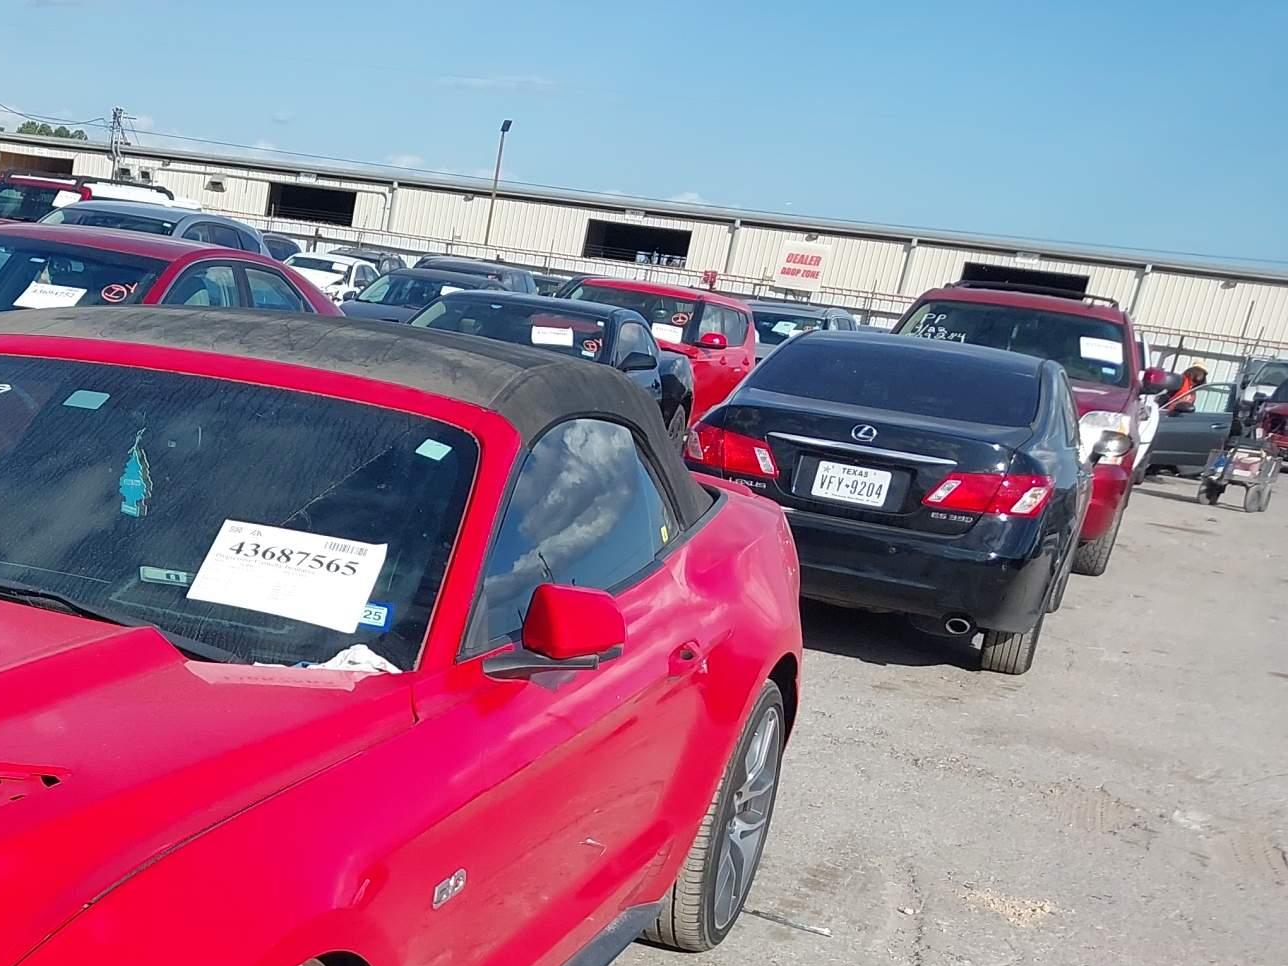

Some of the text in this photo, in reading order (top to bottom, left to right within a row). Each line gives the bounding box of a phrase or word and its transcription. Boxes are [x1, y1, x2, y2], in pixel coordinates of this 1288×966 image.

[786, 252, 823, 267] DEALER
[780, 266, 822, 280] DROP ZONE
[842, 467, 869, 478] TEXAS
[819, 474, 844, 492] VFY
[849, 479, 883, 499] 9204
[930, 511, 948, 520] ES
[229, 541, 360, 577] 43687565
[362, 609, 383, 621] 25
